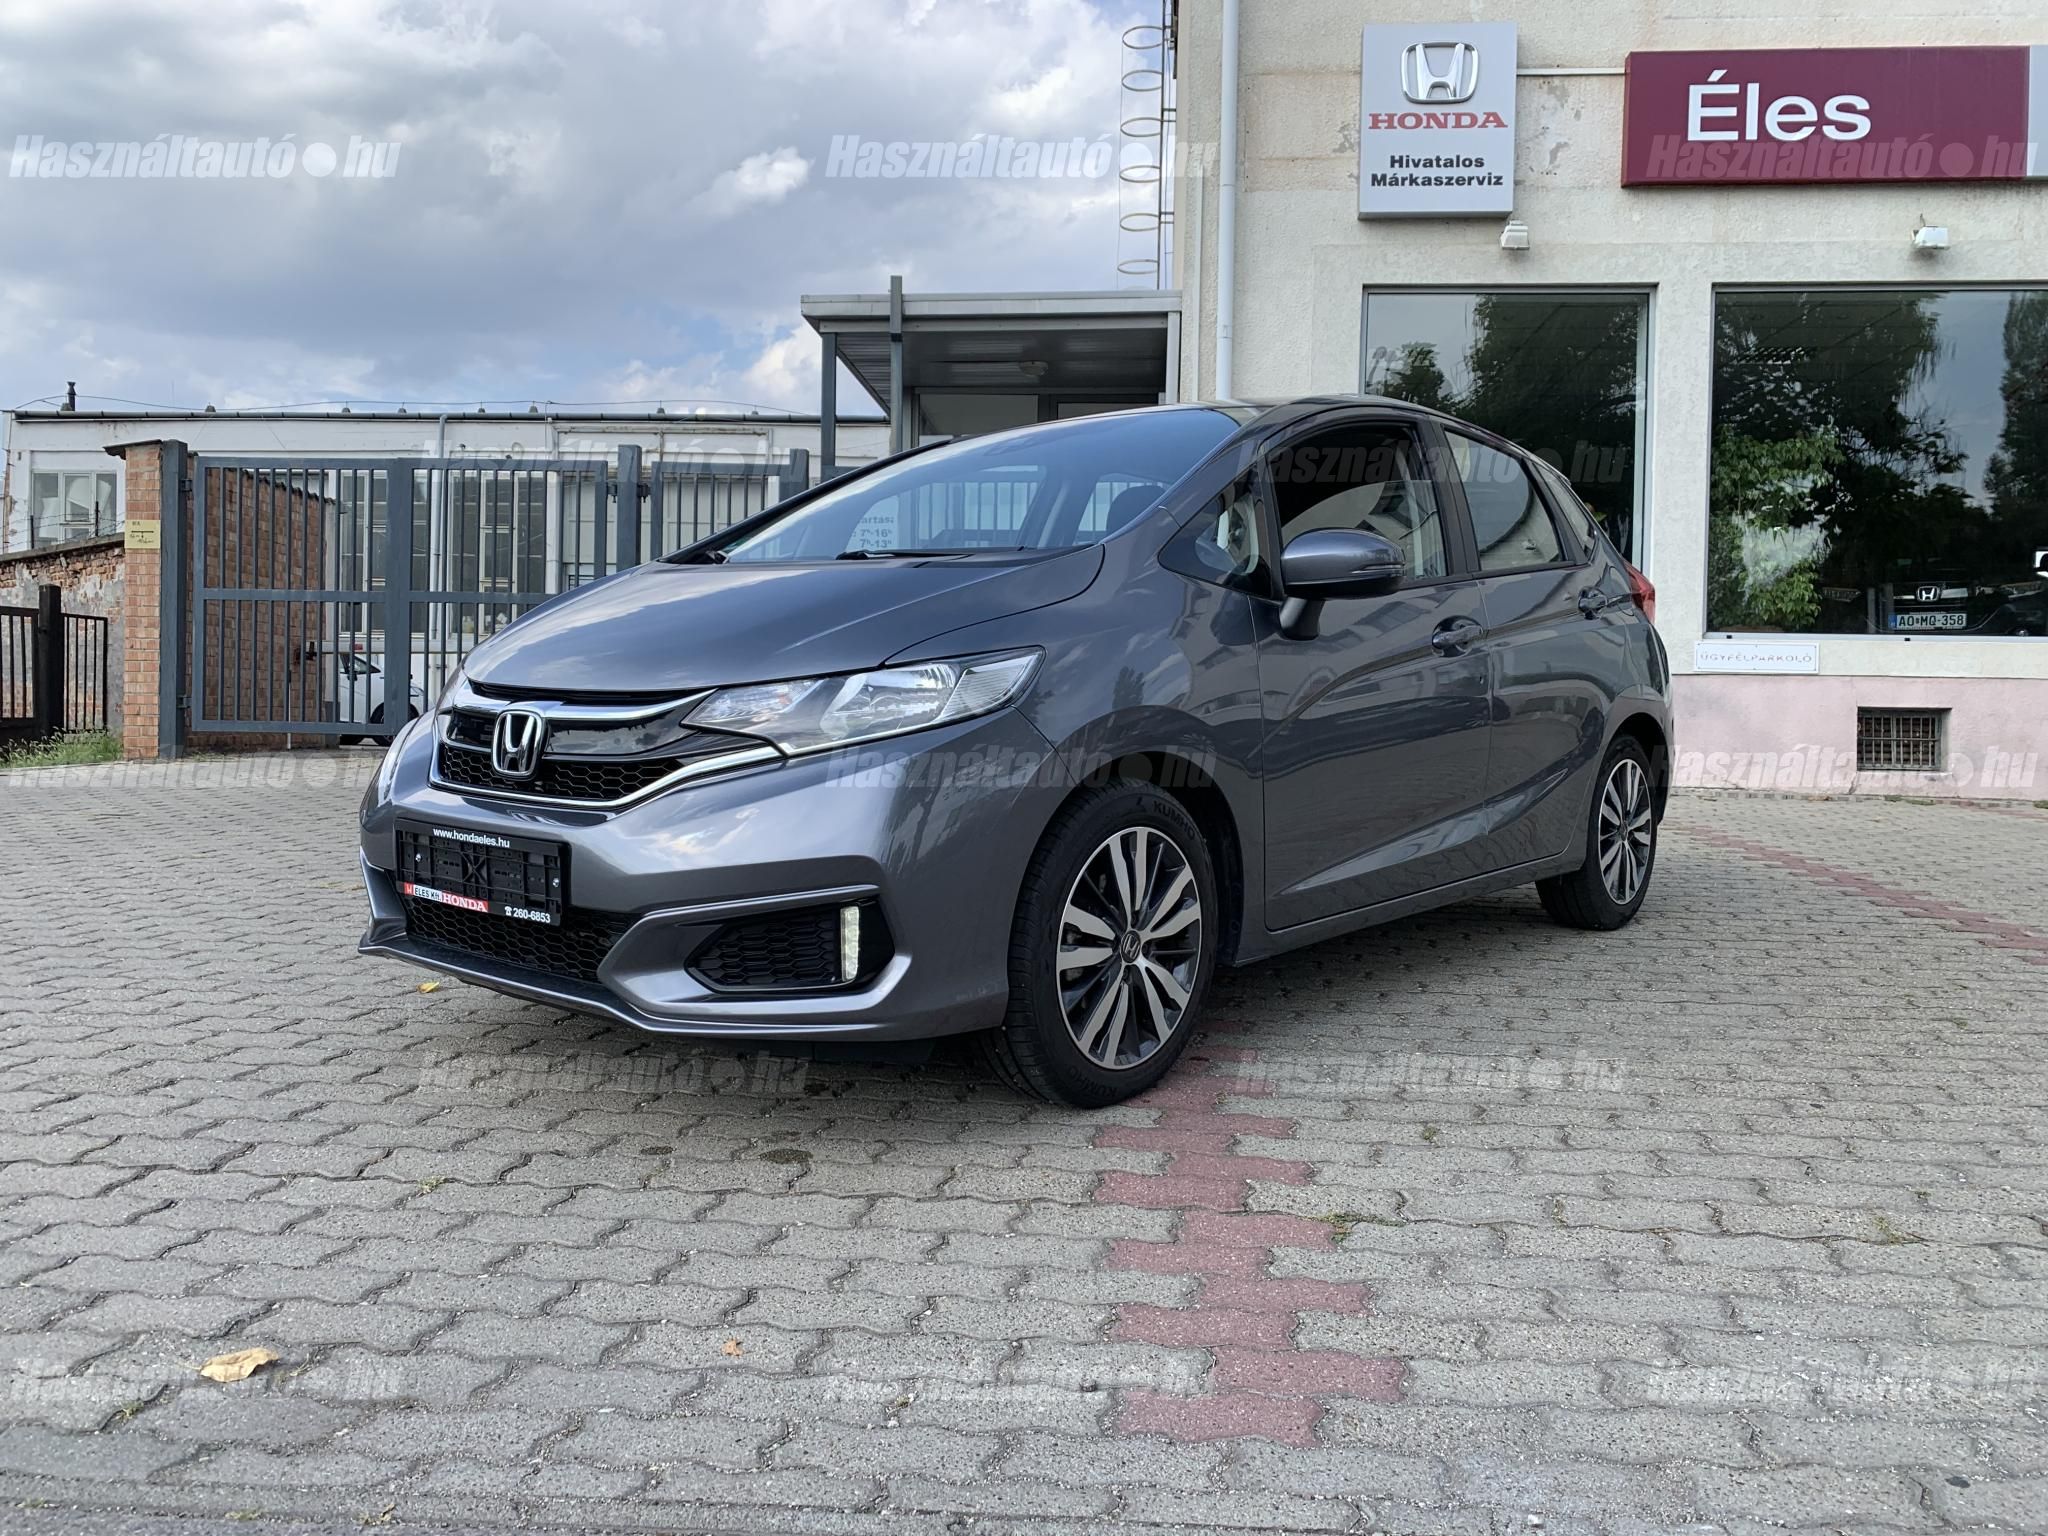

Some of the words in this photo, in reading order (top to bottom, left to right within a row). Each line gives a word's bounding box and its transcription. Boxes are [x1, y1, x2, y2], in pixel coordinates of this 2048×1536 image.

[1687, 69, 1872, 142] Éles
[1368, 112, 1508, 130] HONDA
[1390, 154, 1485, 168] Hivatalos
[1371, 172, 1503, 187] Márkaszerviz
[433, 828, 510, 848] www.hondaeles.hu
[443, 893, 488, 913] HONDA
[513, 907, 551, 924] 260-6853
